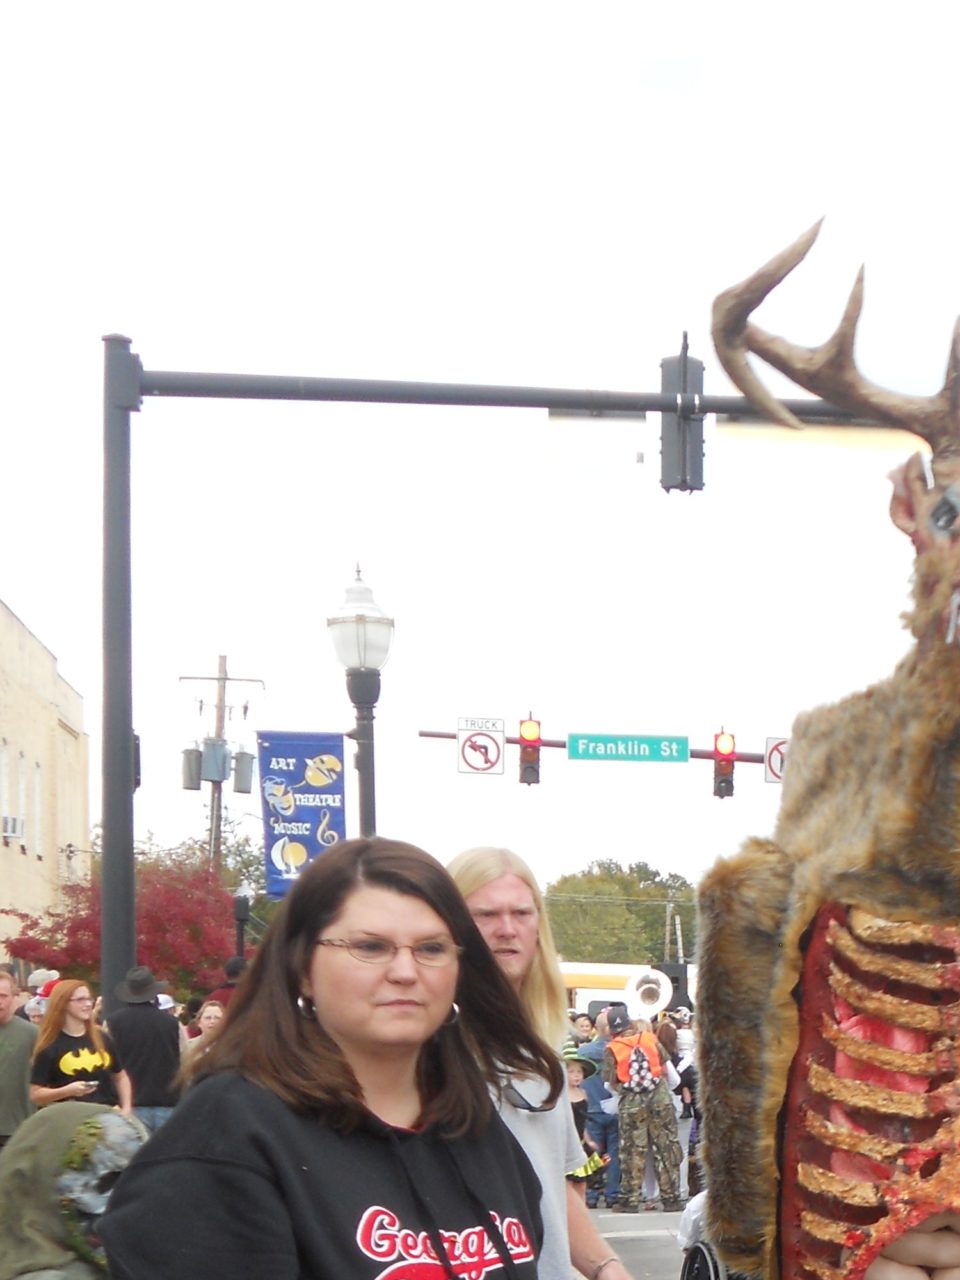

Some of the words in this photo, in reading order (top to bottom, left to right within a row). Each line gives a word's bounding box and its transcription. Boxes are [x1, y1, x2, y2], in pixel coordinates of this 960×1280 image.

[465, 719, 498, 730] TRUCK
[577, 739, 649, 756] Franklin
[660, 741, 679, 757] St
[269, 757, 297, 770] ART
[293, 793, 342, 806] THEATRE
[273, 822, 311, 835] MUSIC
